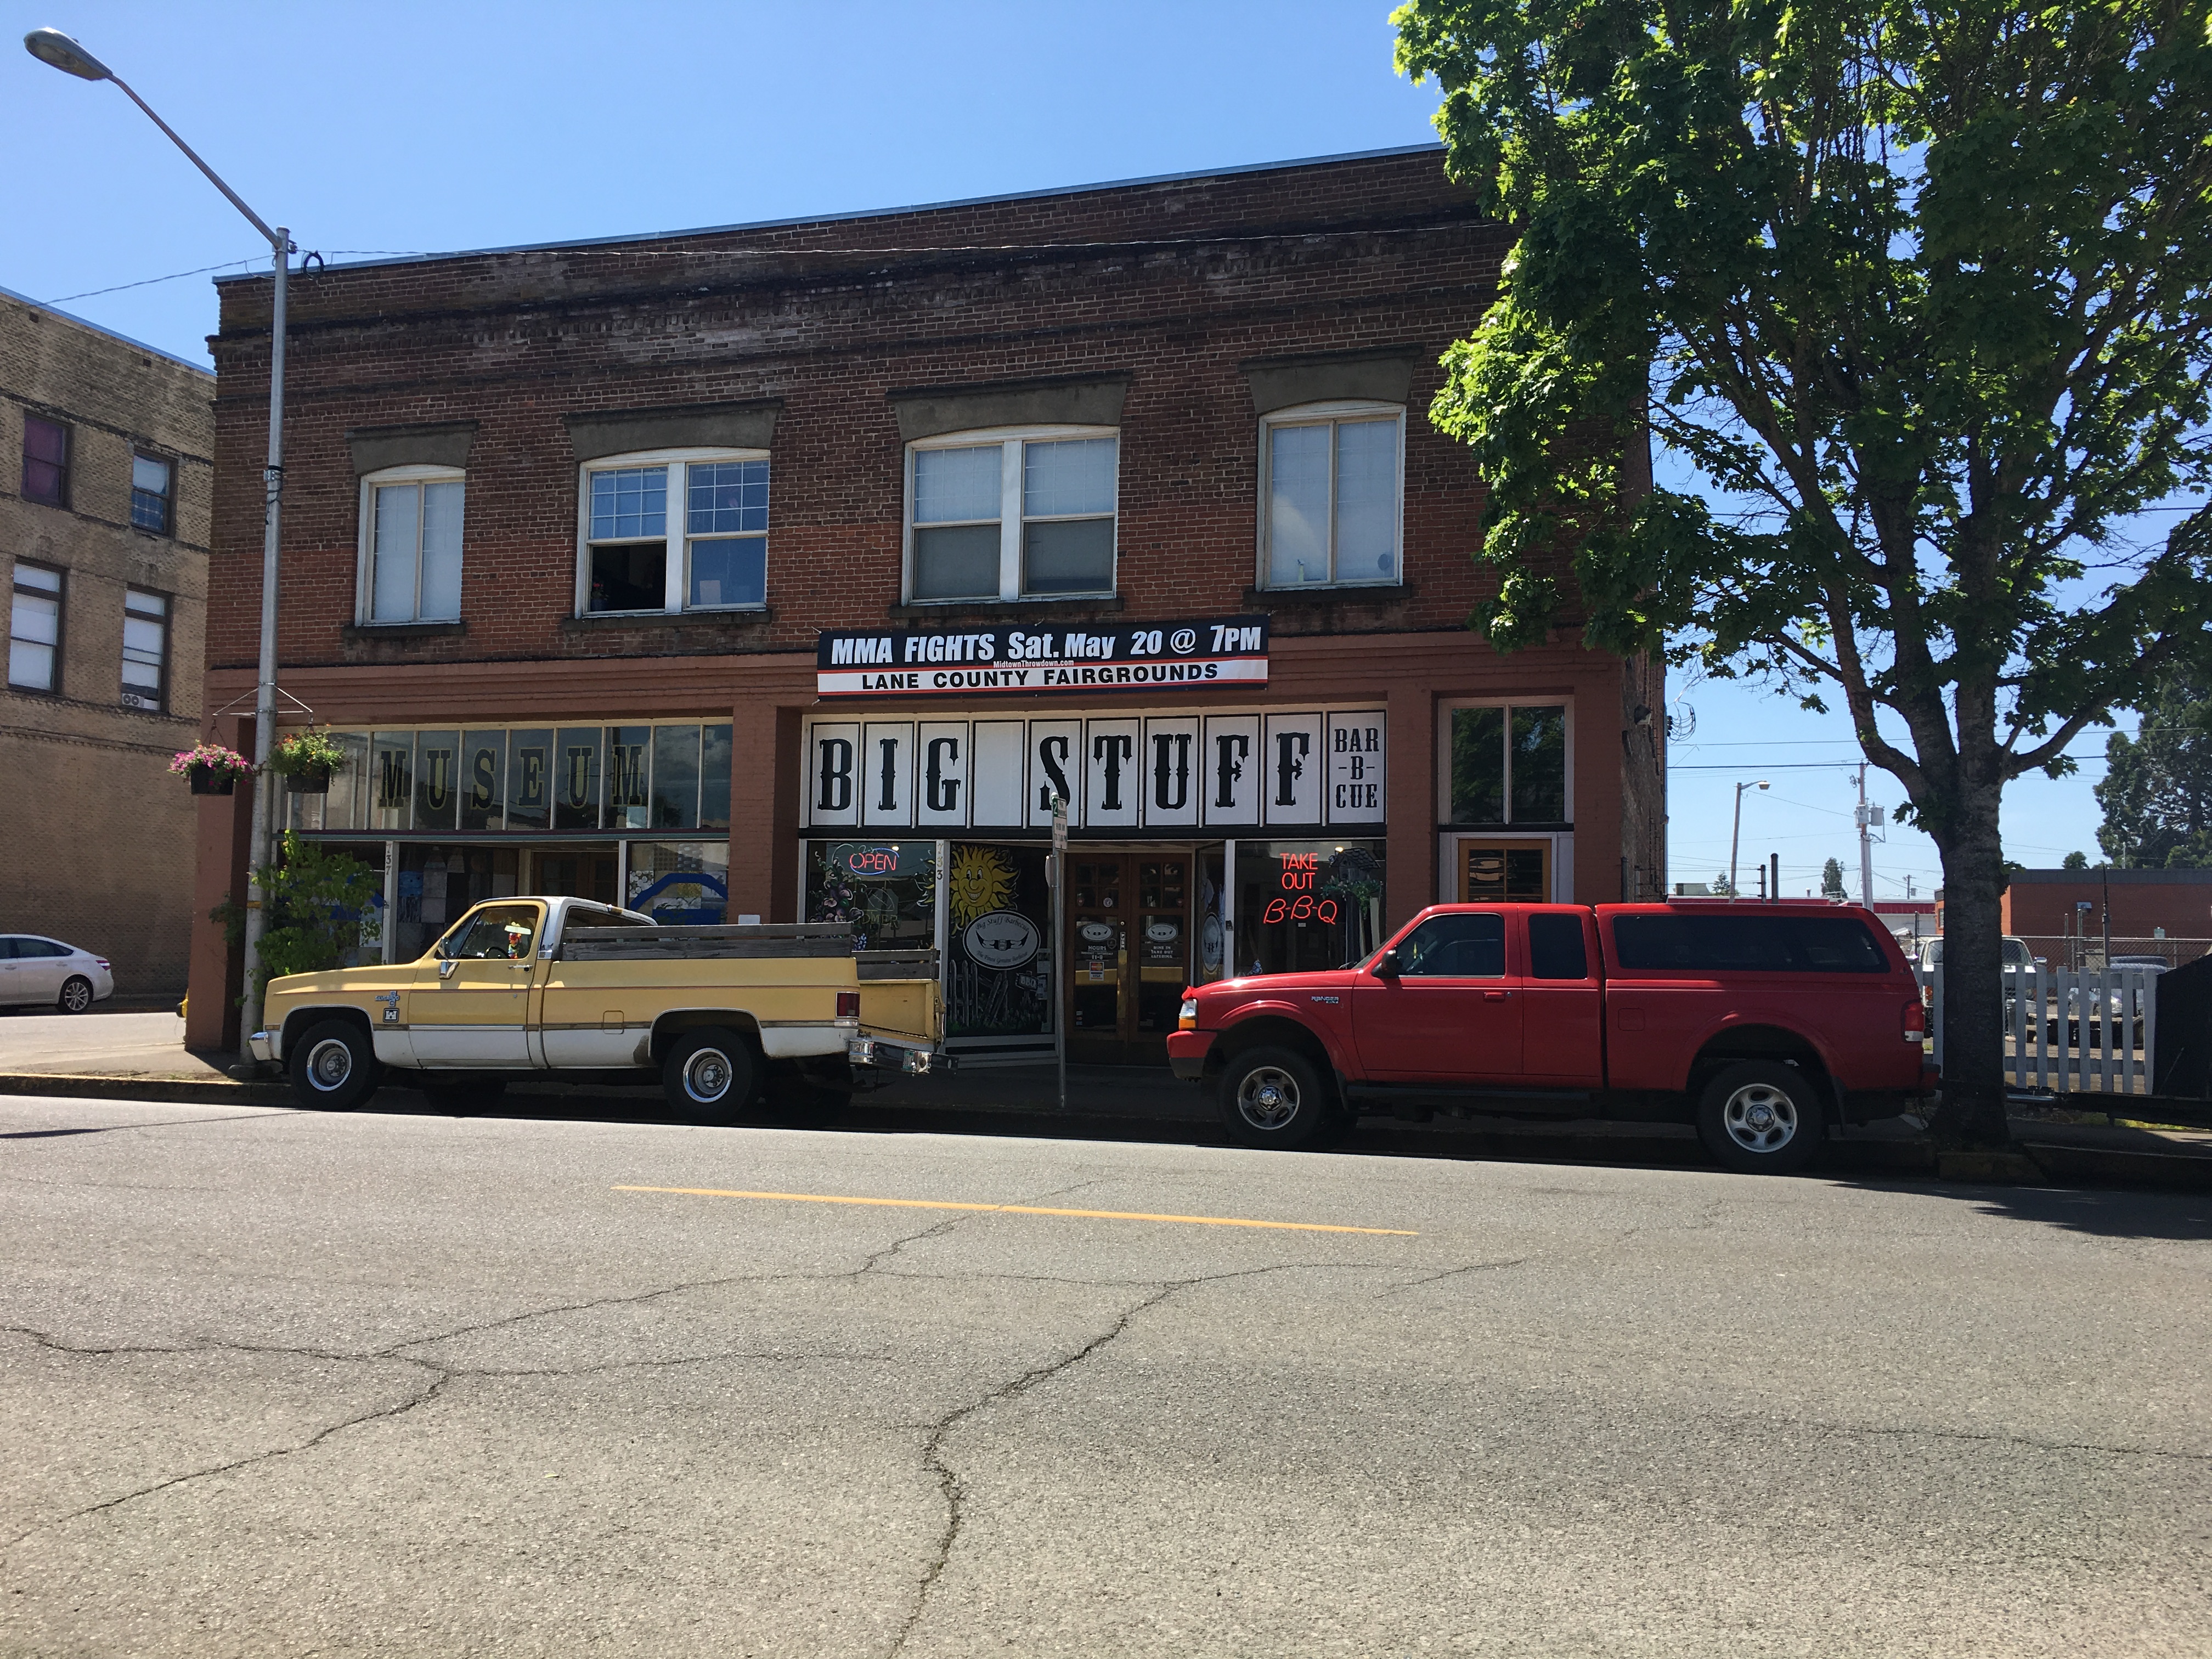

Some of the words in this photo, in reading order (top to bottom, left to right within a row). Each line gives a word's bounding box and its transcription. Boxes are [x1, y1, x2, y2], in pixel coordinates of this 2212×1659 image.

[831, 637, 893, 665] MMA
[904, 633, 995, 663] FIGHTS
[1130, 630, 1163, 656] 20
[1170, 628, 1196, 654] @
[1210, 624, 1262, 652] 7PM
[993, 659, 1074, 668] MidtownThrowdown.com
[862, 673, 919, 690] LANE
[933, 670, 1029, 689] COUNTY
[1043, 663, 1218, 685] FAIRGROUNDS
[1334, 727, 1379, 753] BAR
[377, 745, 643, 810] MUSEUM
[817, 737, 961, 811] BIG
[1039, 731, 1311, 811] STUFF
[1335, 783, 1378, 808] CUE
[1053, 802, 1058, 815] 2
[849, 853, 897, 871] OPEN
[1279, 853, 1318, 870] TAKE
[1282, 872, 1316, 889] OUT
[1263, 895, 1338, 925] B-B-Q
[975, 922, 986, 930] Big
[987, 916, 1005, 926] Stuff
[1005, 916, 1030, 932] Barbecue
